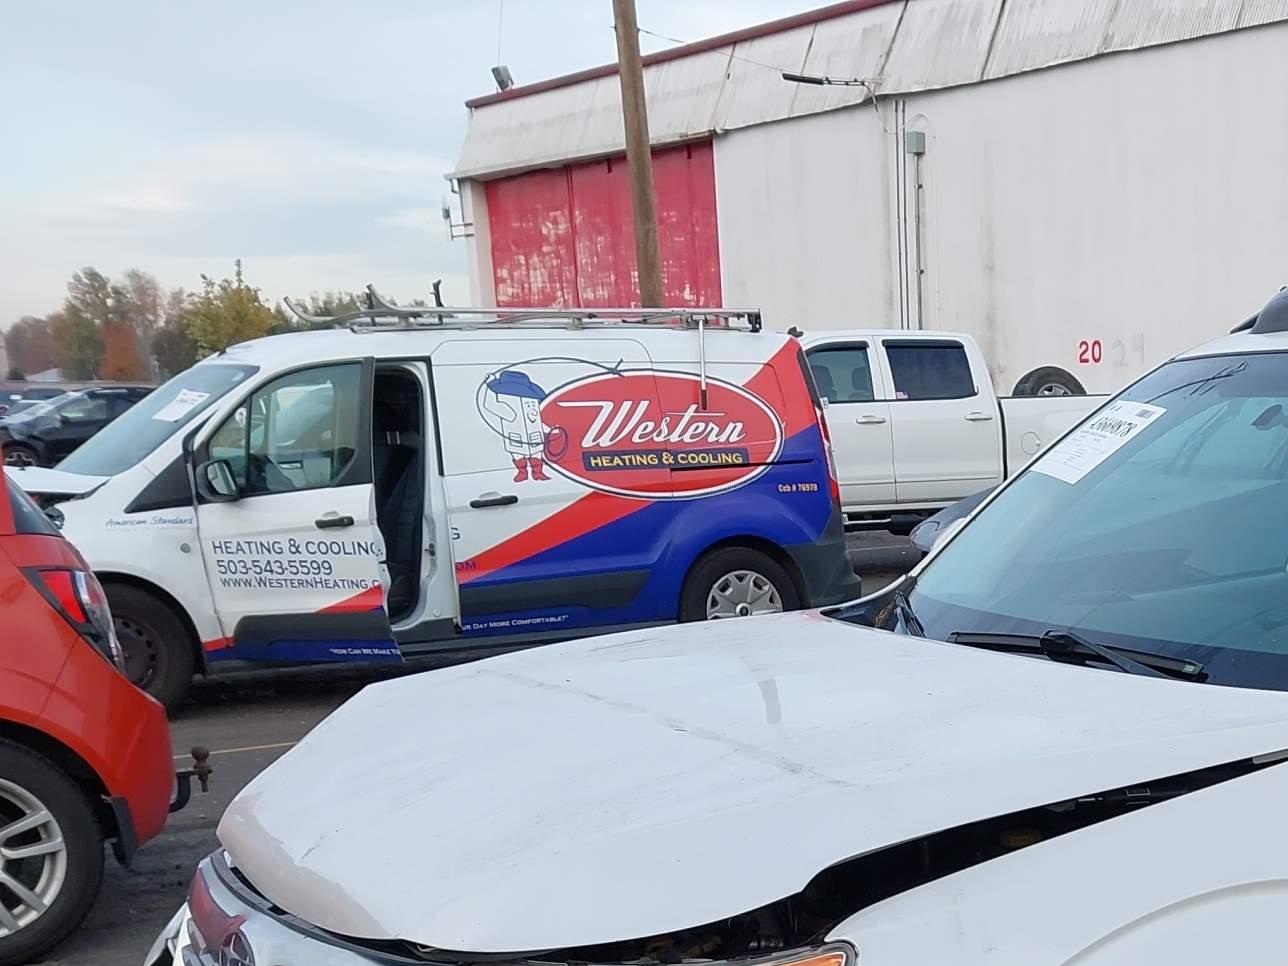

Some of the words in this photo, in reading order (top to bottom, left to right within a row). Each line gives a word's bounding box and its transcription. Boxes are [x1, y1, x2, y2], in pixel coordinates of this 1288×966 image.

[1079, 340, 1102, 364] 20
[557, 400, 746, 448] Western
[590, 452, 658, 467] HEATING
[662, 451, 675, 465] &
[679, 450, 743, 465] COOLING
[212, 541, 283, 555] HEATING
[288, 538, 301, 555] &
[216, 559, 333, 576] 503-543-5599
